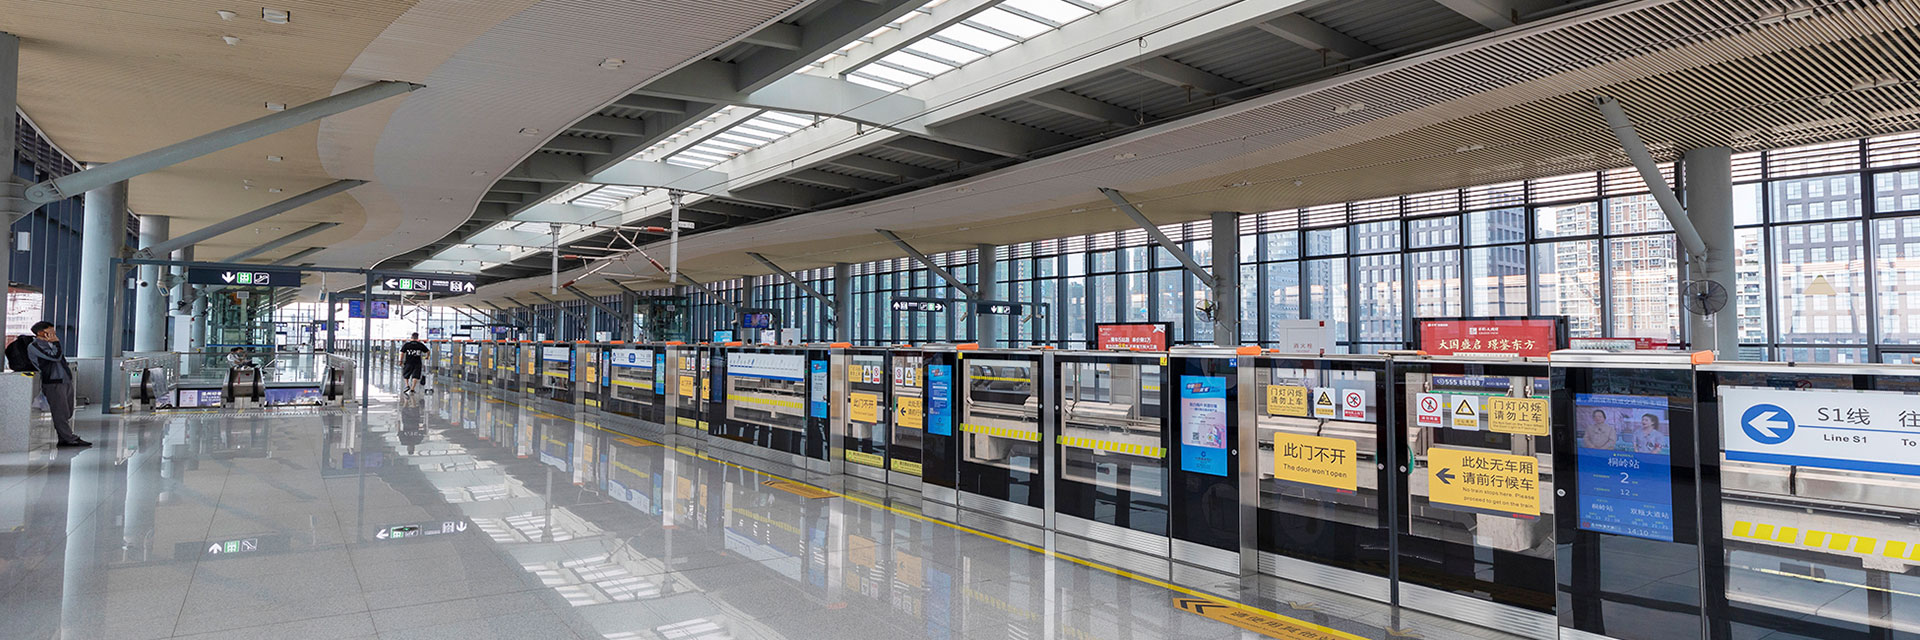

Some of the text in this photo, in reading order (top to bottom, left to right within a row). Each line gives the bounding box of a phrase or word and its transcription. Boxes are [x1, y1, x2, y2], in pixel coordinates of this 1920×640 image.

[1494, 400, 1542, 412] 门灯闪烁
[1494, 410, 1542, 422] 请勿上车
[1817, 407, 1871, 425] S1线
[1823, 433, 1867, 443] Line S1
[1901, 438, 1917, 447] To
[1283, 442, 1347, 465] 此门不开
[1462, 456, 1534, 474] 此处无车厢
[1462, 471, 1534, 491] 请前行候车
[1620, 472, 1629, 484] 2
